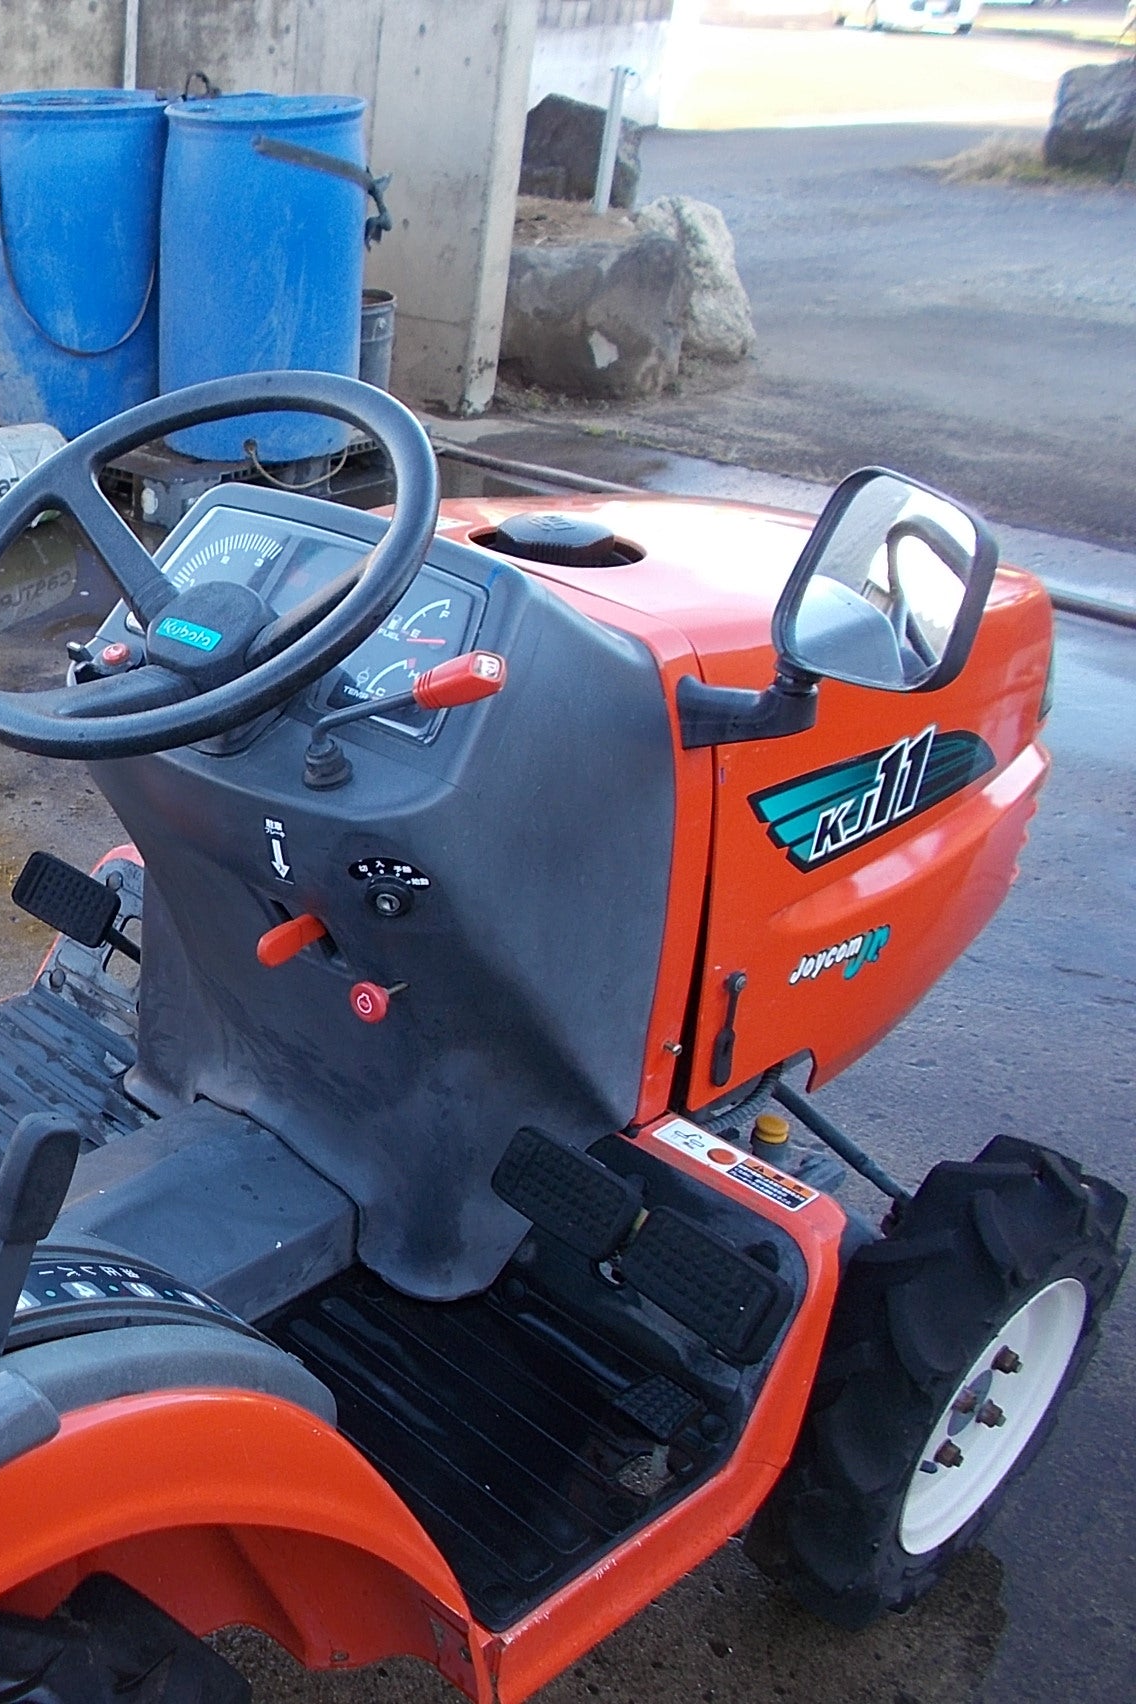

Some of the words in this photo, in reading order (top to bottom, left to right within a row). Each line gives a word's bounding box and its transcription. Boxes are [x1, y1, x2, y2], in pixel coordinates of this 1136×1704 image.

[220, 555, 231, 565] 2
[254, 558, 265, 567] 3
[439, 610, 451, 619] F
[162, 621, 213, 647] Kubota
[378, 628, 400, 642] FUEL
[410, 628, 421, 639] E
[343, 685, 370, 700] TEMP
[376, 688, 386, 697] C
[807, 722, 937, 863] KJ11
[788, 935, 863, 985] Joycom
[71, 1282, 97, 1298] 4
[130, 1282, 155, 1298] 3
